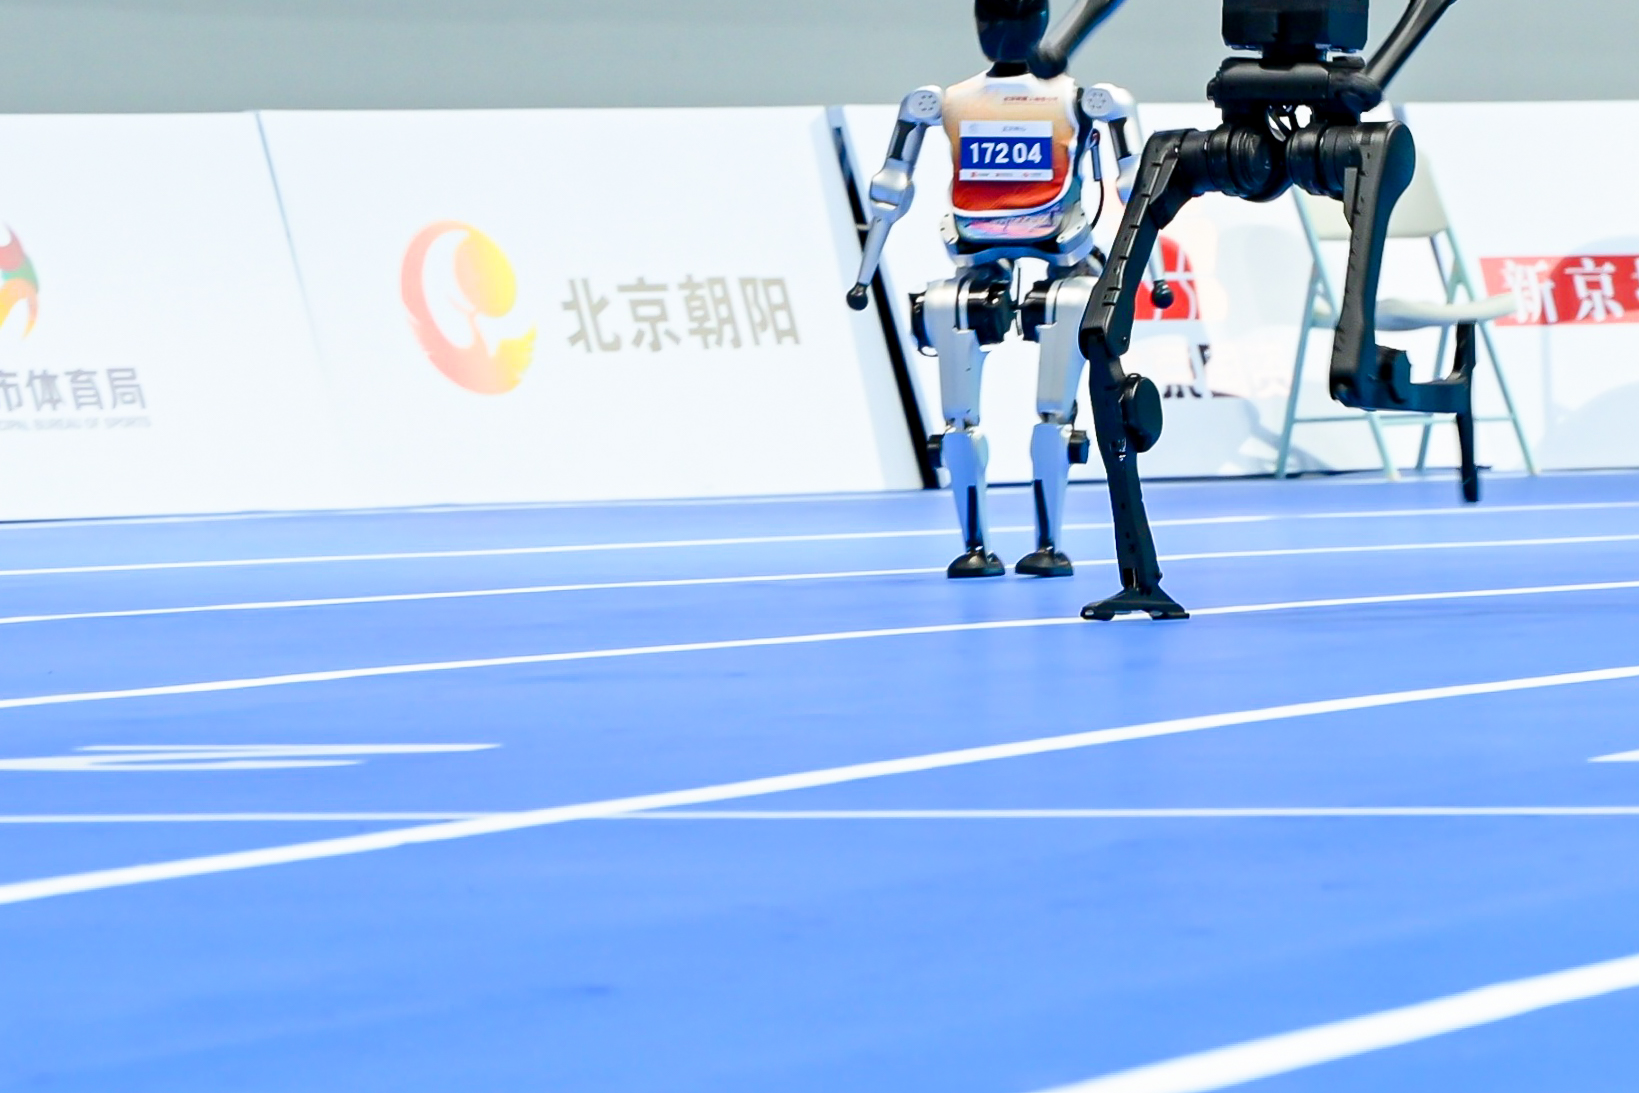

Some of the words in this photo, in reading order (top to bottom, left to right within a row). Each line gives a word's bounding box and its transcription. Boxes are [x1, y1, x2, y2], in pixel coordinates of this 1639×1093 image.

[969, 142, 1042, 164] 17204
[561, 274, 801, 353] 北京朝阳
